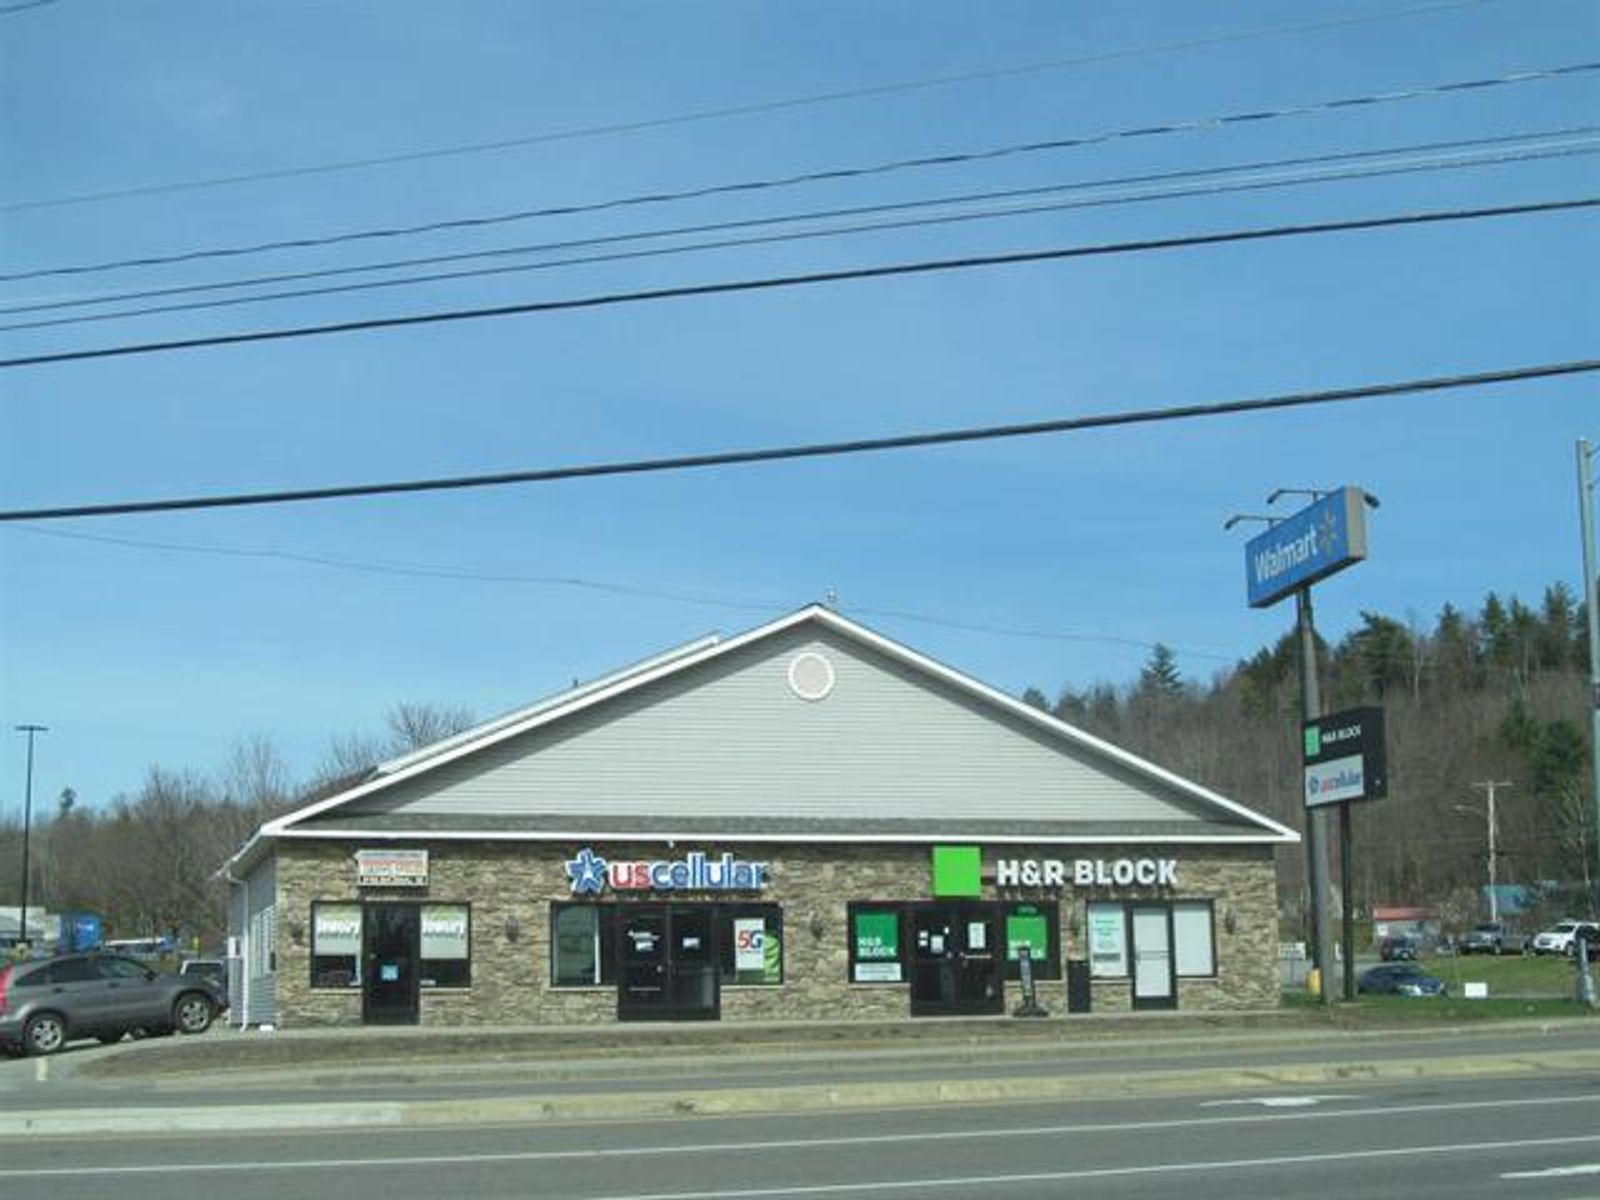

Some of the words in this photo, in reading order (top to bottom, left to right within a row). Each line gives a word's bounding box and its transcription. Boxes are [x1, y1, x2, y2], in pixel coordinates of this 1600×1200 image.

[1255, 522, 1318, 585] Walmart
[610, 853, 765, 889] uscellular
[997, 859, 1064, 886] H&R
[1074, 858, 1177, 885] BLOCK
[738, 929, 763, 949] 5G
